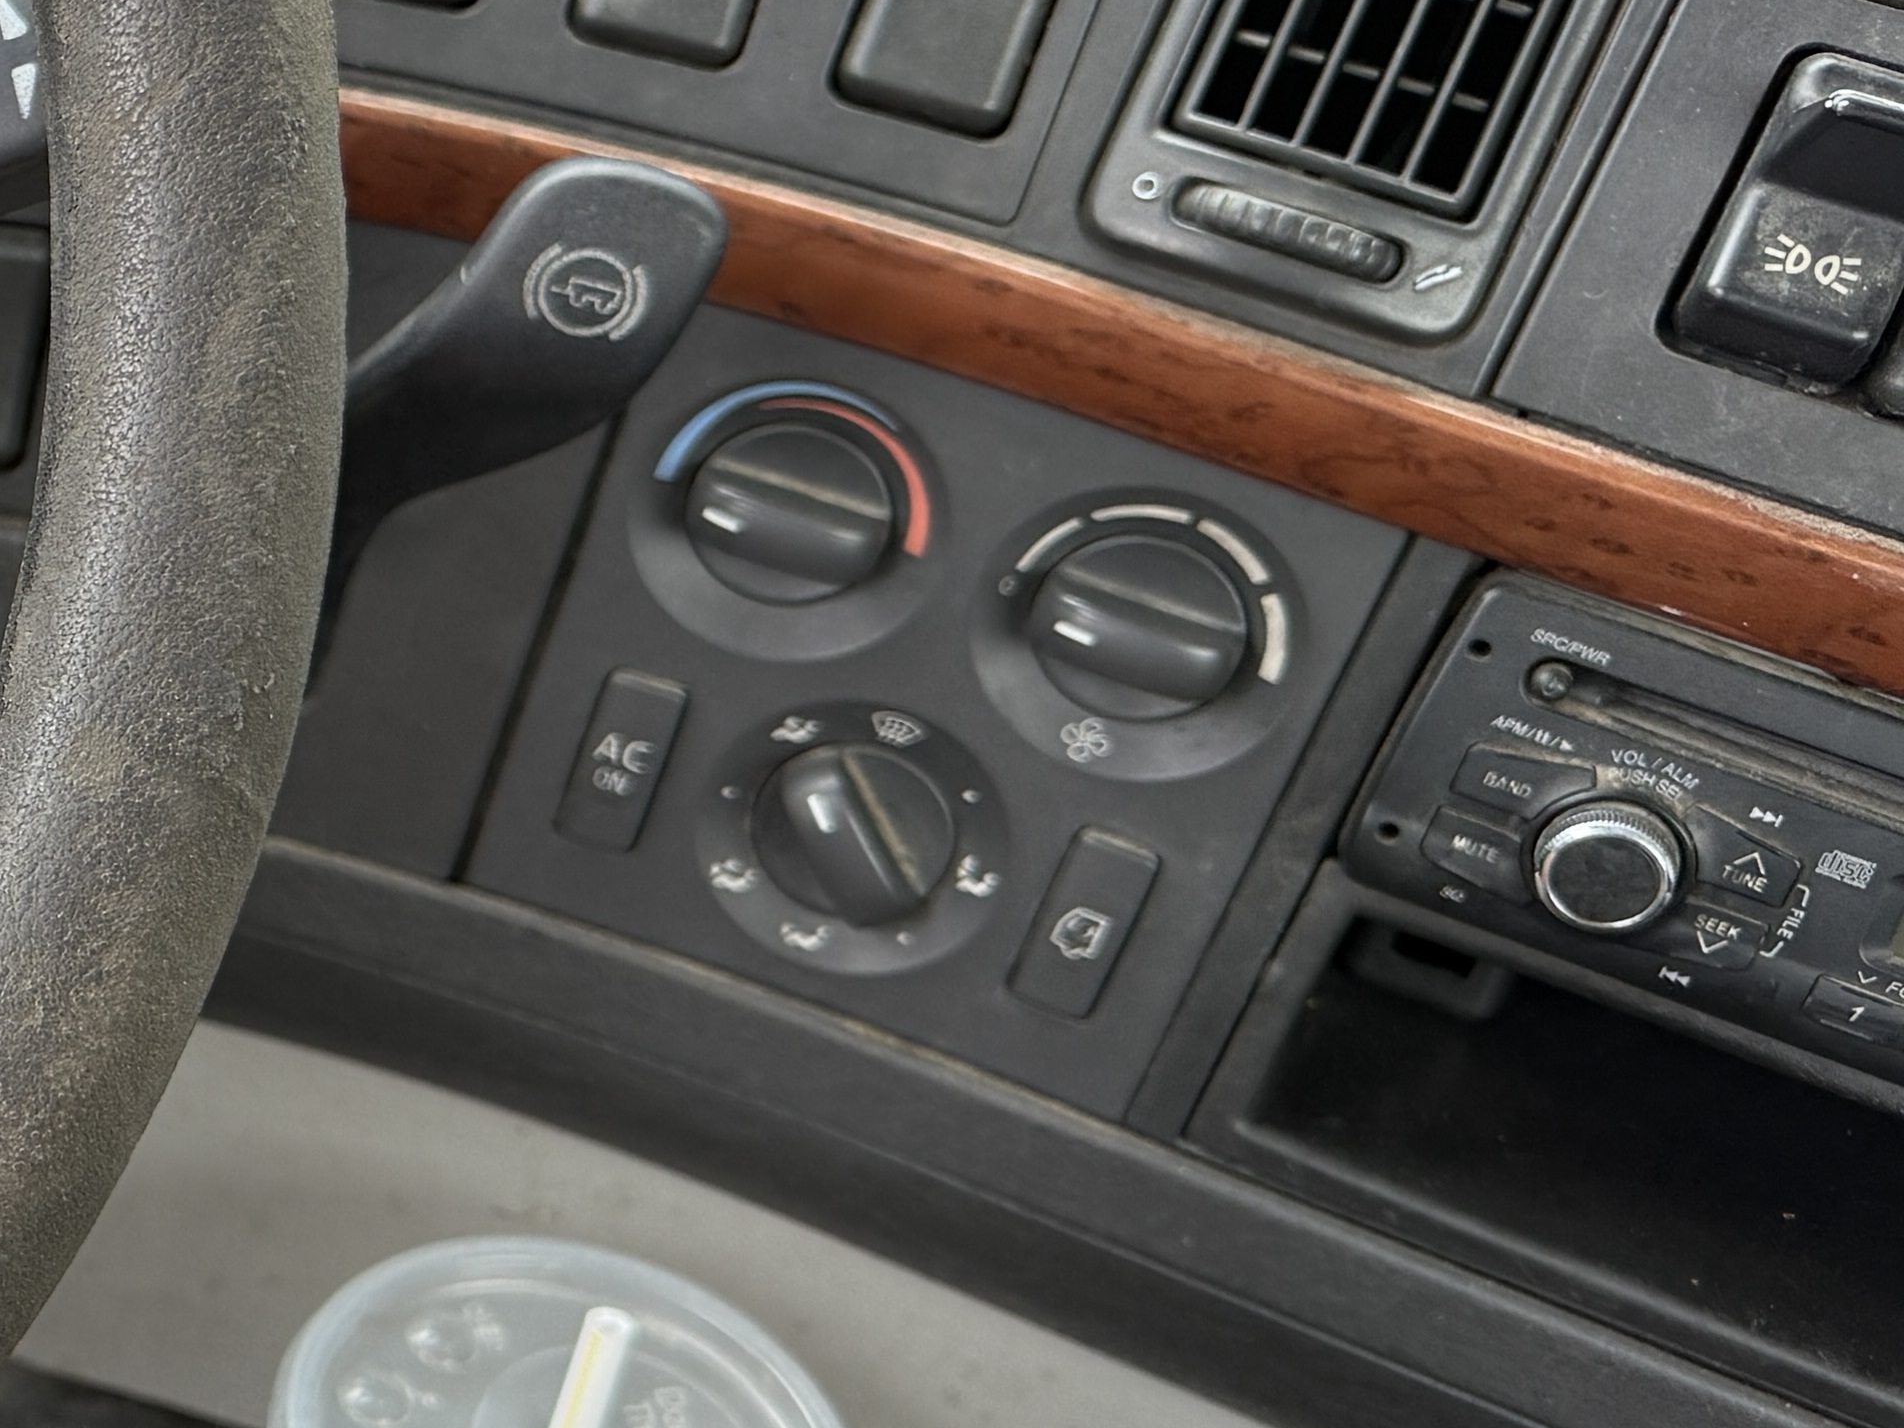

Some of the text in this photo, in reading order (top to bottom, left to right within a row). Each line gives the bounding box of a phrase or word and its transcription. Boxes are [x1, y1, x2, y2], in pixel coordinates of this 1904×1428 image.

[1529, 627, 1612, 667] SRC/PWR
[592, 732, 657, 774] AC
[1482, 770, 1532, 799] BAND
[1611, 749, 1647, 768] VOL
[1661, 762, 1699, 789] ALM
[1451, 833, 1500, 864] MUTE
[1722, 864, 1769, 894] TUNE
[1694, 913, 1744, 941] SEEK
[1776, 906, 1807, 941] FILE
[1849, 1005, 1869, 1022] 1
